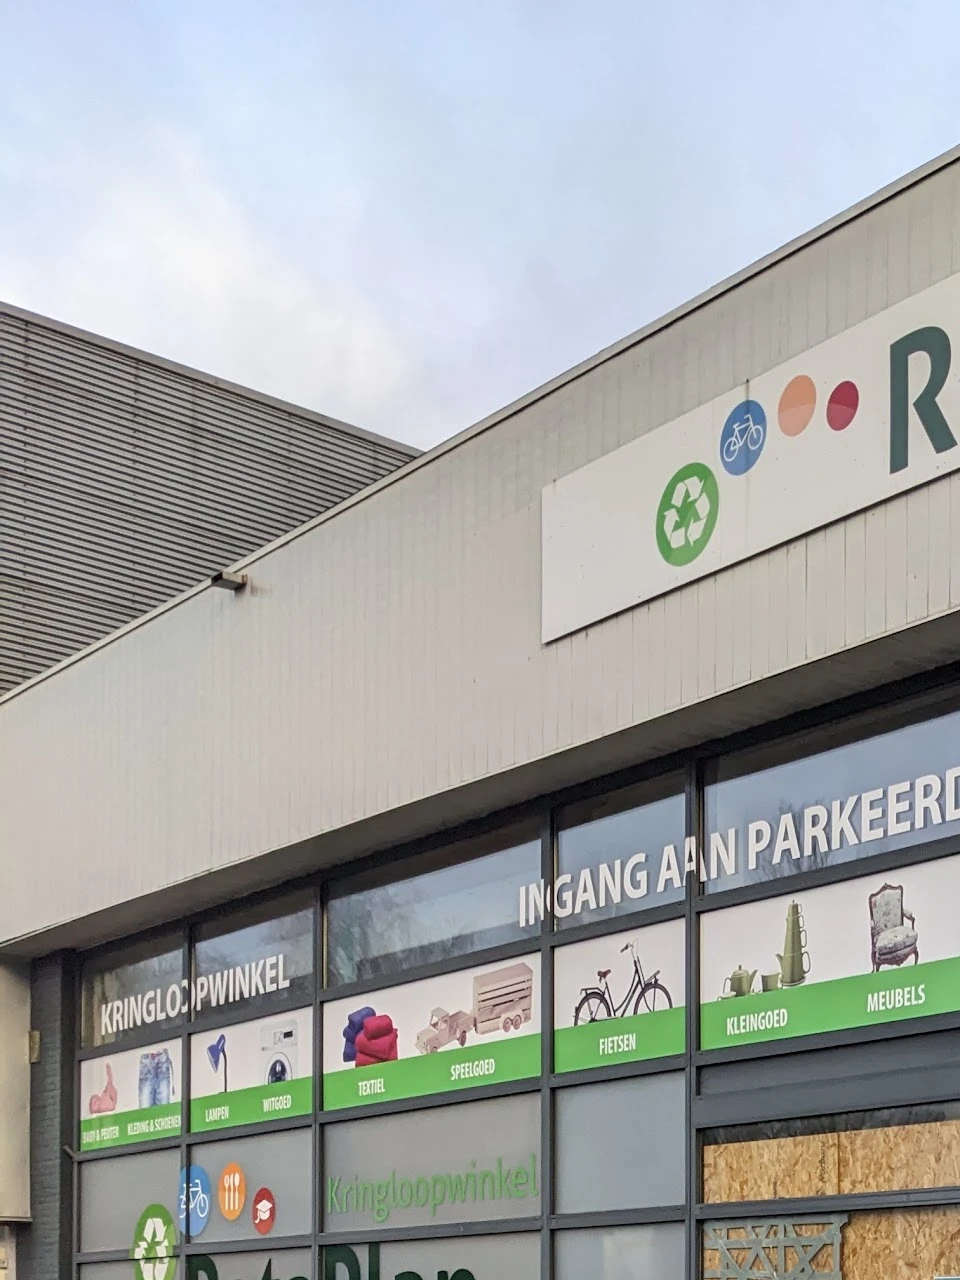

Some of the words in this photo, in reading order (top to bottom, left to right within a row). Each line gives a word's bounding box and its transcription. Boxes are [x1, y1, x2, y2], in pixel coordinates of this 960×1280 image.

[519, 853, 648, 928] INGANG
[657, 827, 738, 893] AAN
[101, 954, 290, 1035] KRINGLOOPWINKEL
[867, 984, 926, 1012] MEUBELS
[726, 1008, 788, 1036] KLEINGOED
[599, 1033, 636, 1056] FIETSEN
[450, 1058, 495, 1081] SPEELGOED
[358, 1078, 385, 1096] TEXTIEL
[205, 1106, 229, 1122] LAMPEN
[262, 1095, 292, 1112] WITGOED
[127, 1120, 149, 1136] KLEDING
[327, 1152, 539, 1224] Kringloopwinkel
